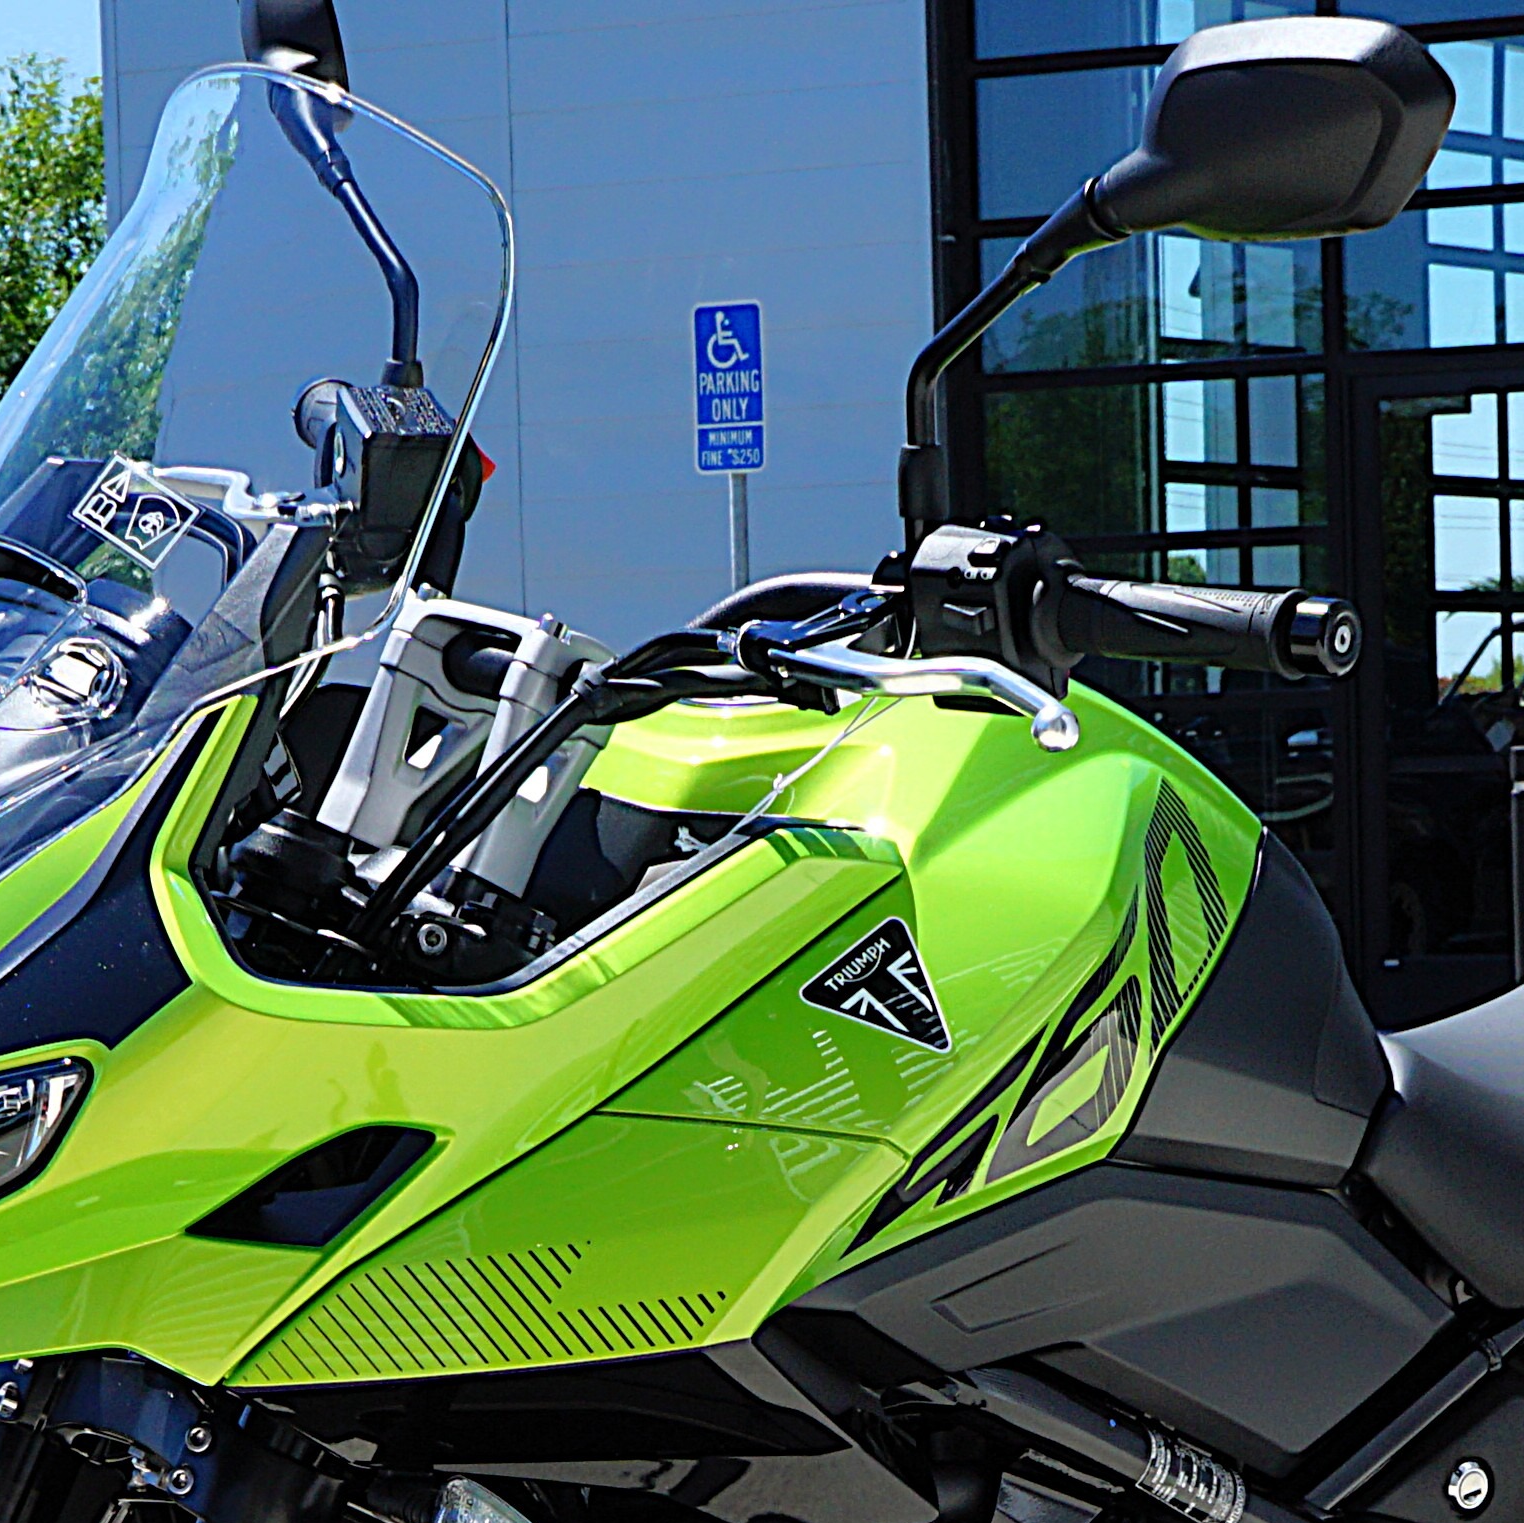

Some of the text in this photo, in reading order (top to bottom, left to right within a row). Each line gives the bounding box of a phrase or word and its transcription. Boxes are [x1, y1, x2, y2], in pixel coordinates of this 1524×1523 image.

[699, 369, 760, 395] PARKING
[711, 396, 749, 422] ONLY
[708, 429, 753, 446] MINIMUM
[701, 448, 760, 467] FINE $250
[823, 936, 892, 992] TRIUMPH
